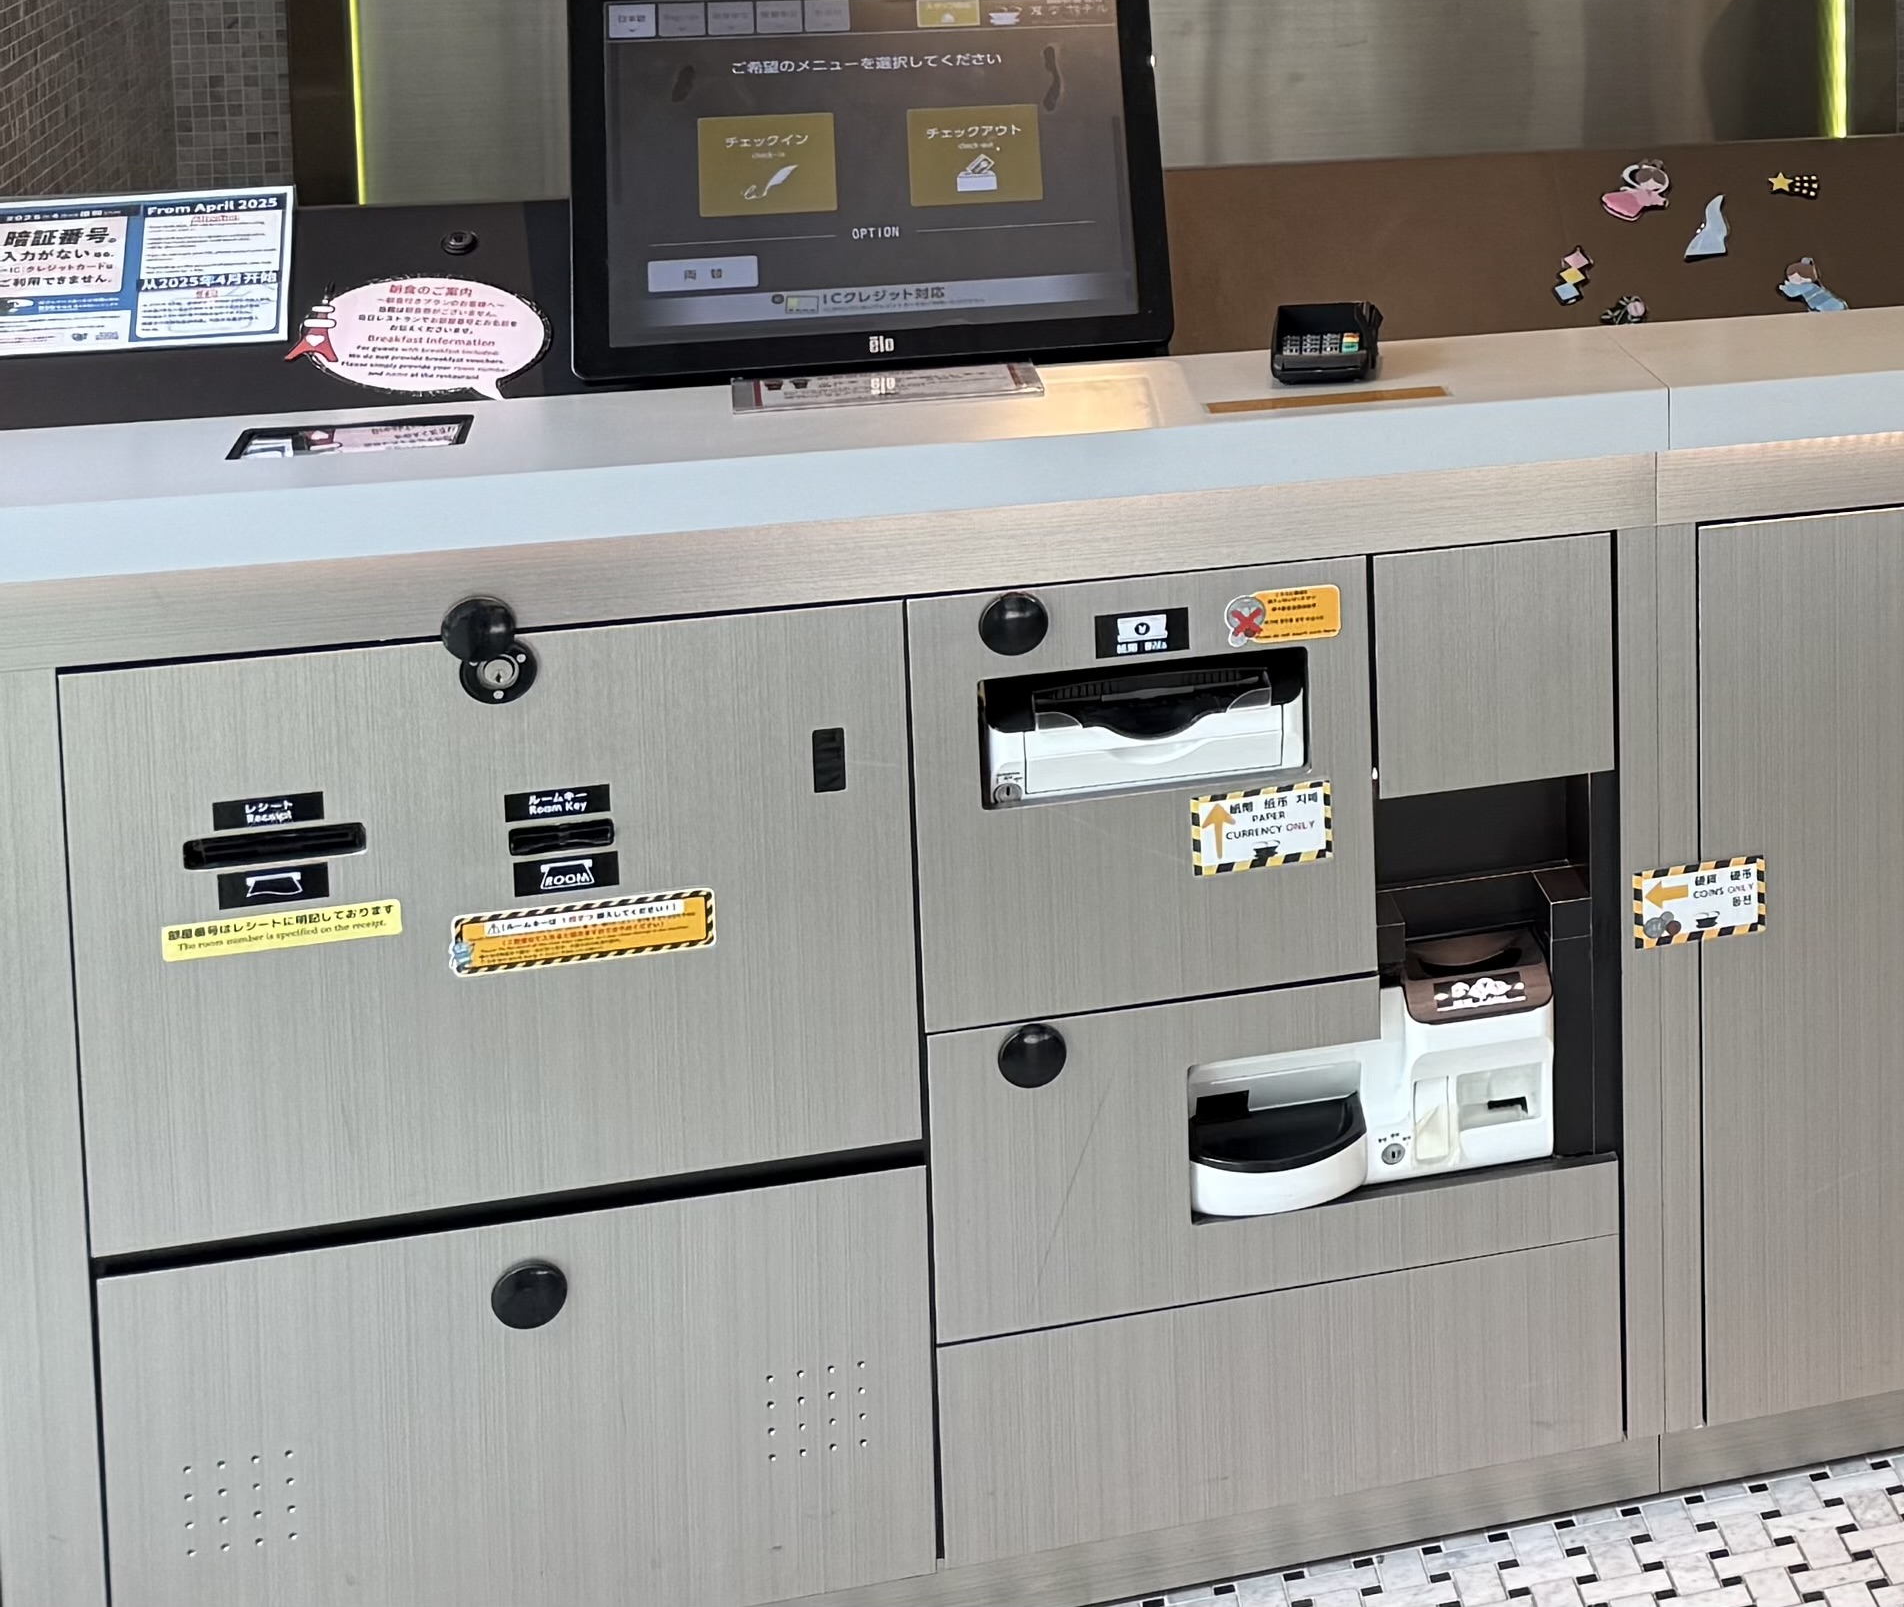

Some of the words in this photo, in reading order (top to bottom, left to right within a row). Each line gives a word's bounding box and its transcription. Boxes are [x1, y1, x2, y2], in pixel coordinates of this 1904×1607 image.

[731, 53, 1002, 75] ご希望のメニューを選択してください
[925, 124, 1022, 139] チェックアウト
[725, 133, 809, 148] チェックイン
[147, 205, 191, 216] From
[194, 200, 235, 214] April
[238, 197, 278, 210] 2025
[851, 226, 900, 240] OPTION
[822, 286, 945, 305] ICクレジット対応
[367, 335, 423, 344] Breakfast
[426, 334, 496, 347] Information
[245, 800, 293, 814] レシート
[528, 803, 562, 815] Room
[565, 800, 588, 813] Key
[246, 809, 293, 824] Receipt
[1252, 811, 1286, 823] PAPER
[1225, 825, 1283, 840] CURRENCY
[1286, 820, 1315, 832] ONLY
[546, 873, 590, 886] ROOM
[1693, 887, 1724, 899] COINS
[1727, 882, 1754, 894] ONLY
[178, 941, 196, 951] The
[198, 939, 224, 949] room
[226, 933, 264, 946] number
[266, 932, 275, 941] is
[276, 925, 320, 941] specified
[334, 921, 350, 932] the
